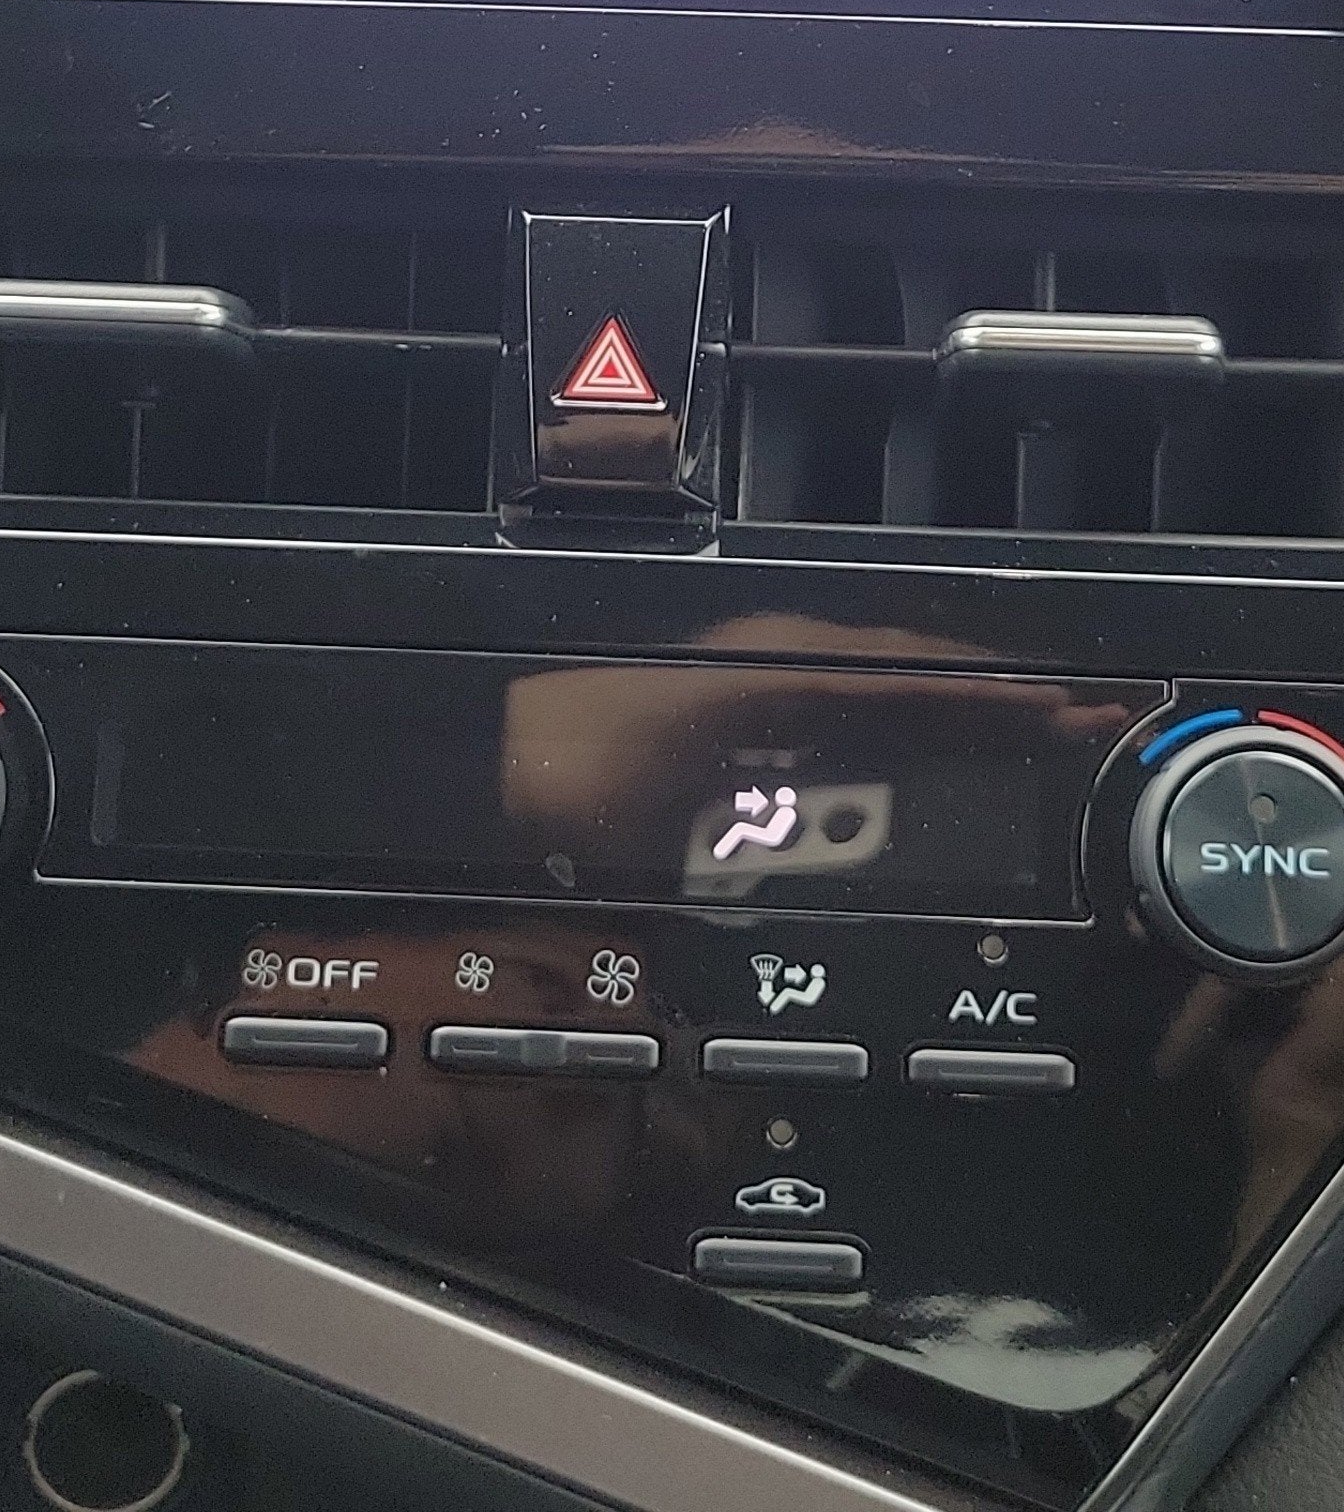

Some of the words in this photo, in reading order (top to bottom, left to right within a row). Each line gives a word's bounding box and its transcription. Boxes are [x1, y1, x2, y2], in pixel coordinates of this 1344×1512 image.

[1200, 843, 1330, 877] SYNC
[286, 960, 379, 989] OFF
[948, 991, 1038, 1024] A/C
